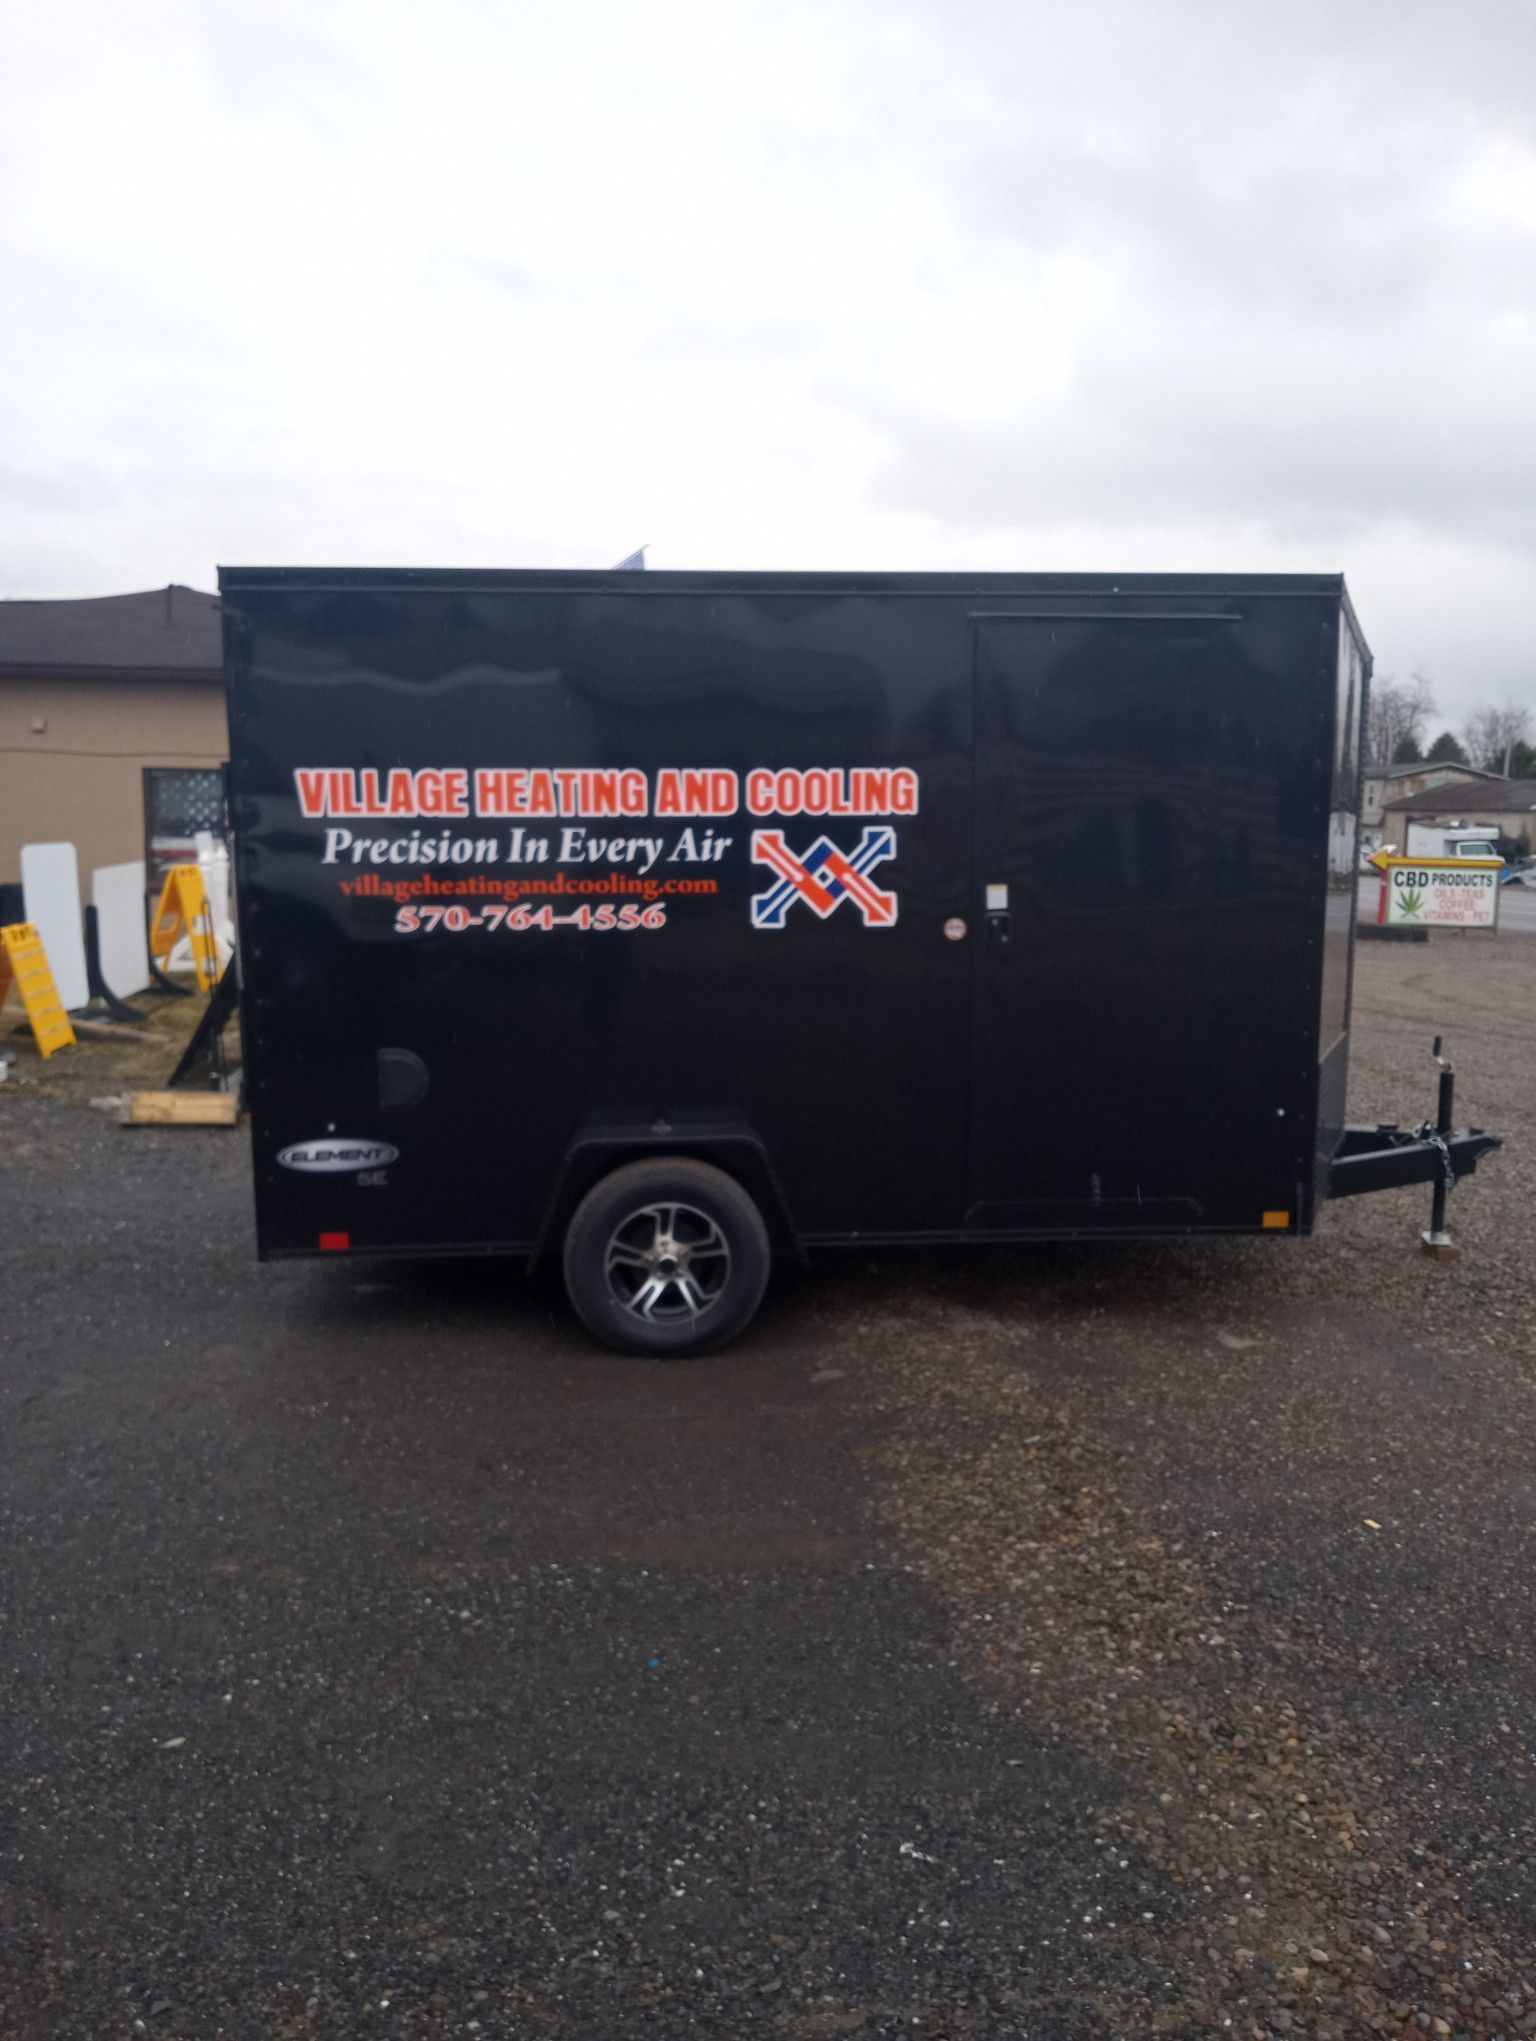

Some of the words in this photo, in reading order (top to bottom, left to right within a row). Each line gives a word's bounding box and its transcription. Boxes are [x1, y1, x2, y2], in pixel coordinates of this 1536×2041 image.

[294, 768, 469, 818] VILLAGE
[475, 768, 648, 818] HEATING
[654, 768, 738, 817] AND
[746, 767, 918, 816] COOLING
[321, 827, 499, 864] Precision
[506, 827, 549, 863] In
[557, 827, 663, 875] Every
[667, 827, 733, 862] Air
[339, 872, 718, 901] villageheatingandcooling.com
[1394, 871, 1429, 887] CBD
[1431, 873, 1494, 887] PRODUCTS
[394, 902, 667, 933] 570-764-4556
[290, 1148, 382, 1162] ELEMENT
